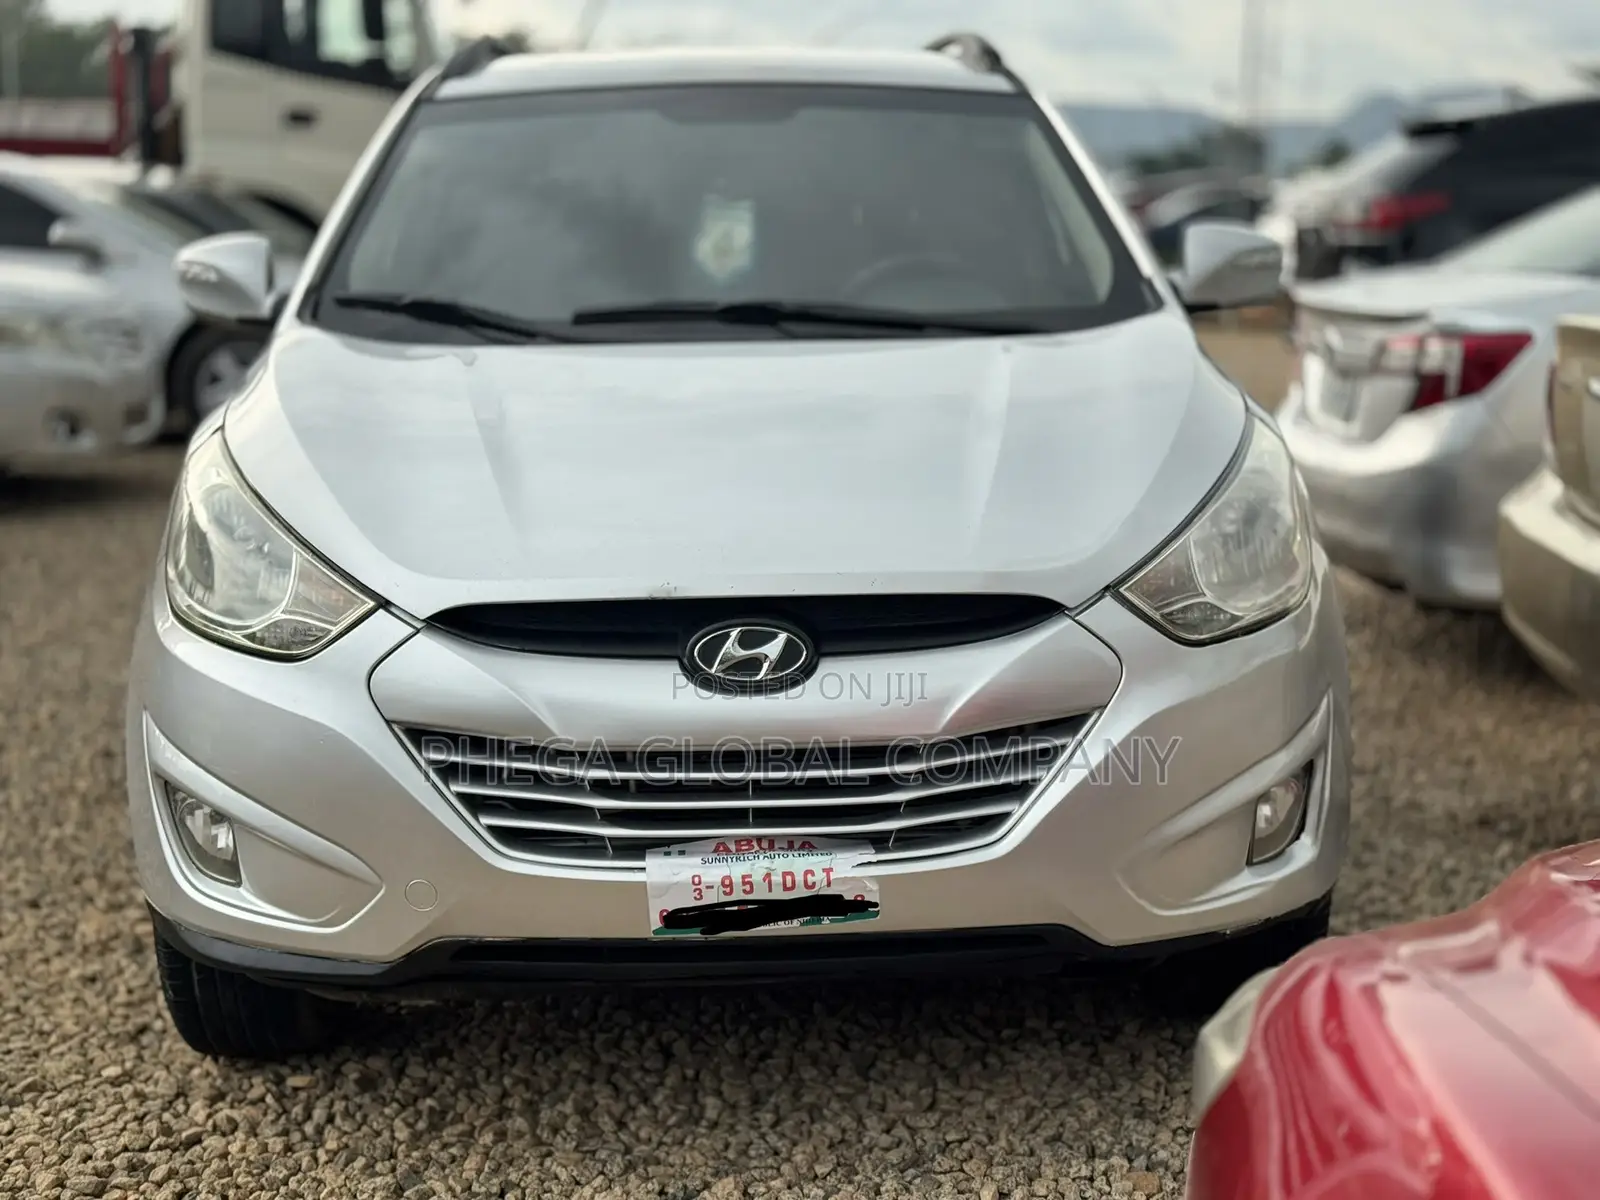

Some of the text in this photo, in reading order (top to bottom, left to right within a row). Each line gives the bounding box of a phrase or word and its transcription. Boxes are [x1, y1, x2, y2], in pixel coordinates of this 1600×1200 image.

[711, 837, 818, 853] ABUJA
[700, 853, 760, 865] SUNNYRICH
[763, 852, 789, 861] AUTO
